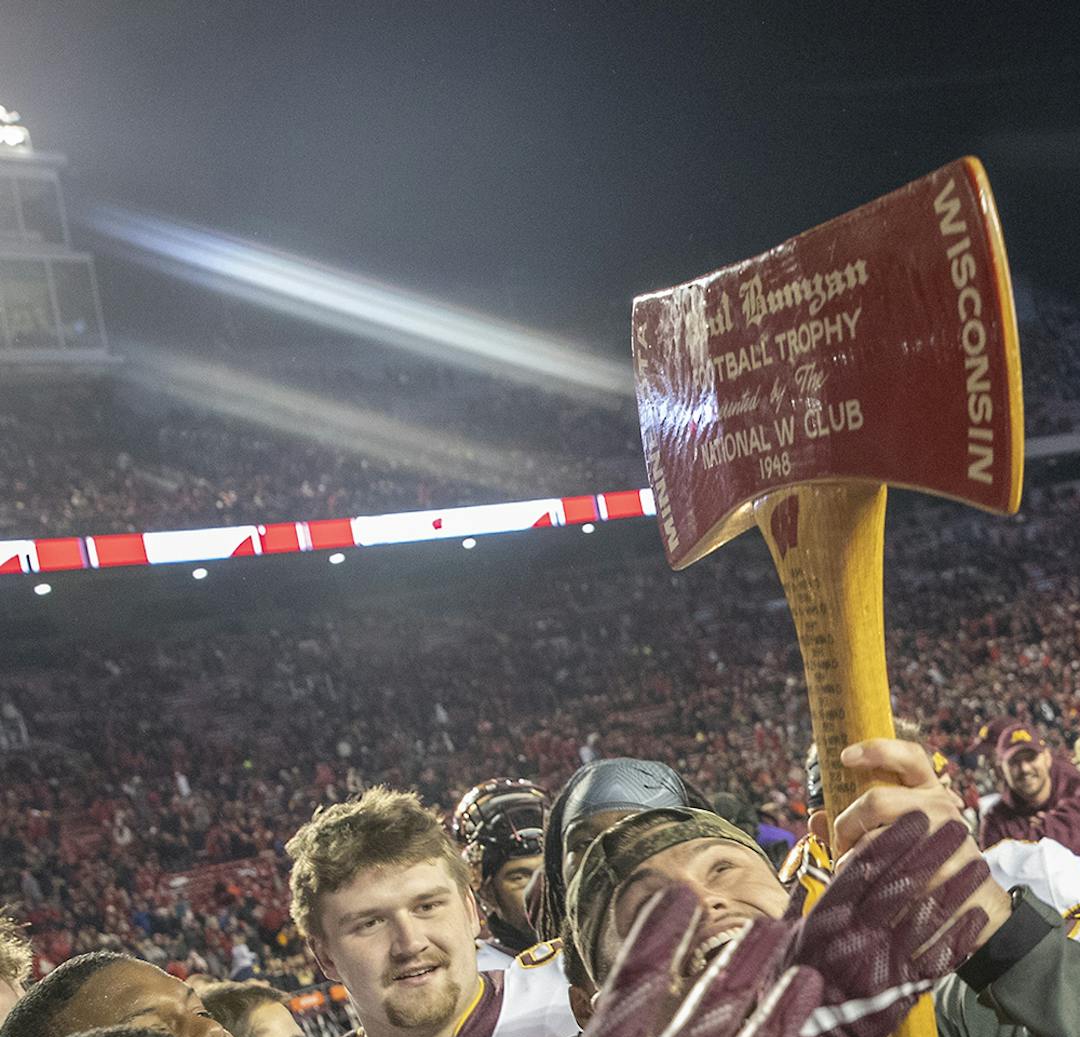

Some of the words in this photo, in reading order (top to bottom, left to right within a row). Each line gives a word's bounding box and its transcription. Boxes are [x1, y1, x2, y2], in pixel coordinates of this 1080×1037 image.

[738, 258, 869, 328] Bunyan
[775, 307, 862, 360] TROPHY
[932, 179, 994, 486] WISCONSIN
[795, 362, 831, 394] The
[701, 425, 772, 470] NATIONAL
[774, 415, 795, 447] W
[804, 399, 864, 439] CLUB
[759, 452, 792, 480] 1948
